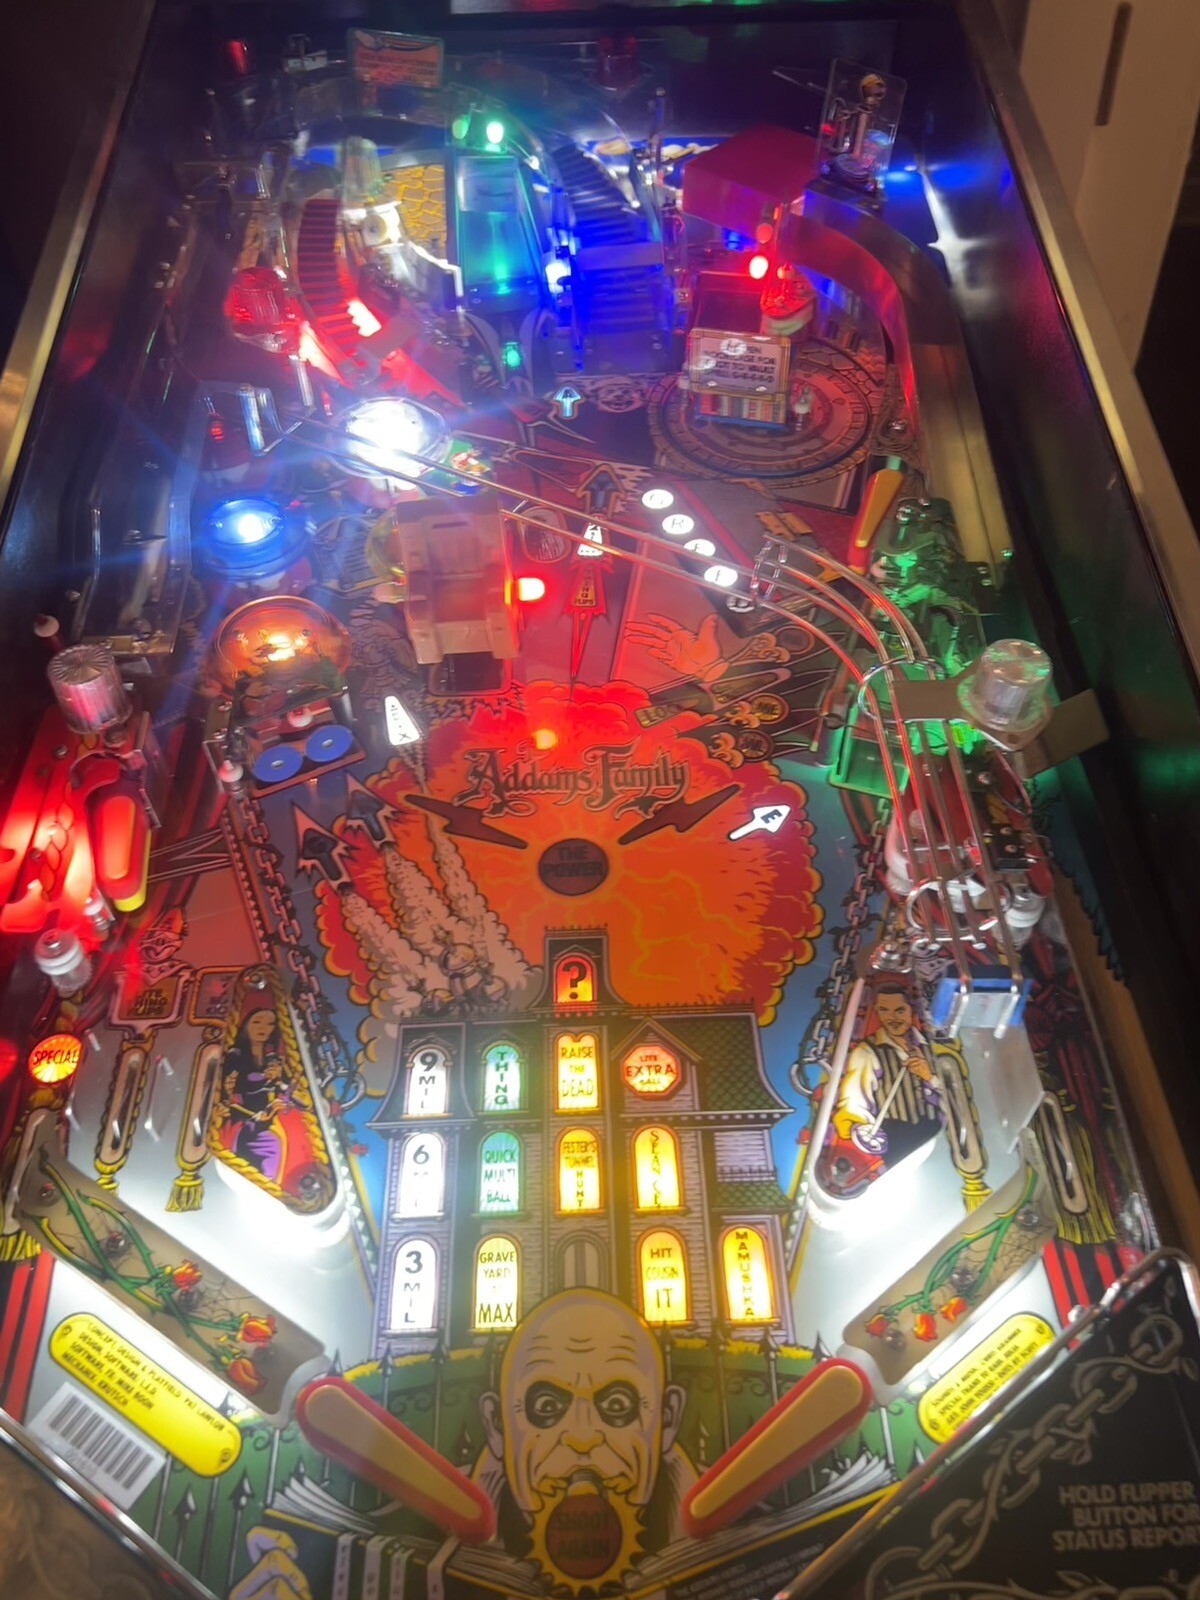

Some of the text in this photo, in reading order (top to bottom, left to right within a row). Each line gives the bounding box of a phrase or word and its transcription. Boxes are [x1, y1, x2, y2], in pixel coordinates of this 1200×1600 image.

[453, 735, 691, 821] Addams Family
[558, 845, 589, 861] THE
[542, 860, 602, 878] POWER
[562, 961, 588, 1000] ?
[33, 1049, 80, 1066] SPECIAL
[420, 1052, 438, 1072] 9
[561, 1047, 594, 1059] RAISE
[494, 1051, 509, 1106] THING
[626, 1063, 677, 1077] EXTRA
[562, 1078, 595, 1097] DEAD
[412, 1144, 430, 1165] 6
[484, 1149, 516, 1164] QUICK
[487, 1190, 511, 1204] BALL
[404, 1250, 423, 1274] 3
[479, 1250, 516, 1264] GRAVE
[650, 1247, 673, 1259] HIT
[483, 1267, 511, 1279] YARD
[736, 1231, 755, 1317] MAMUSHKA
[656, 1288, 673, 1309] IT
[478, 1302, 514, 1324] MAX
[1058, 1480, 1197, 1505] HOLD FLIPPER
[1072, 1503, 1200, 1527] BUTTON FOR
[1052, 1524, 1200, 1551] STATUS REPOR
